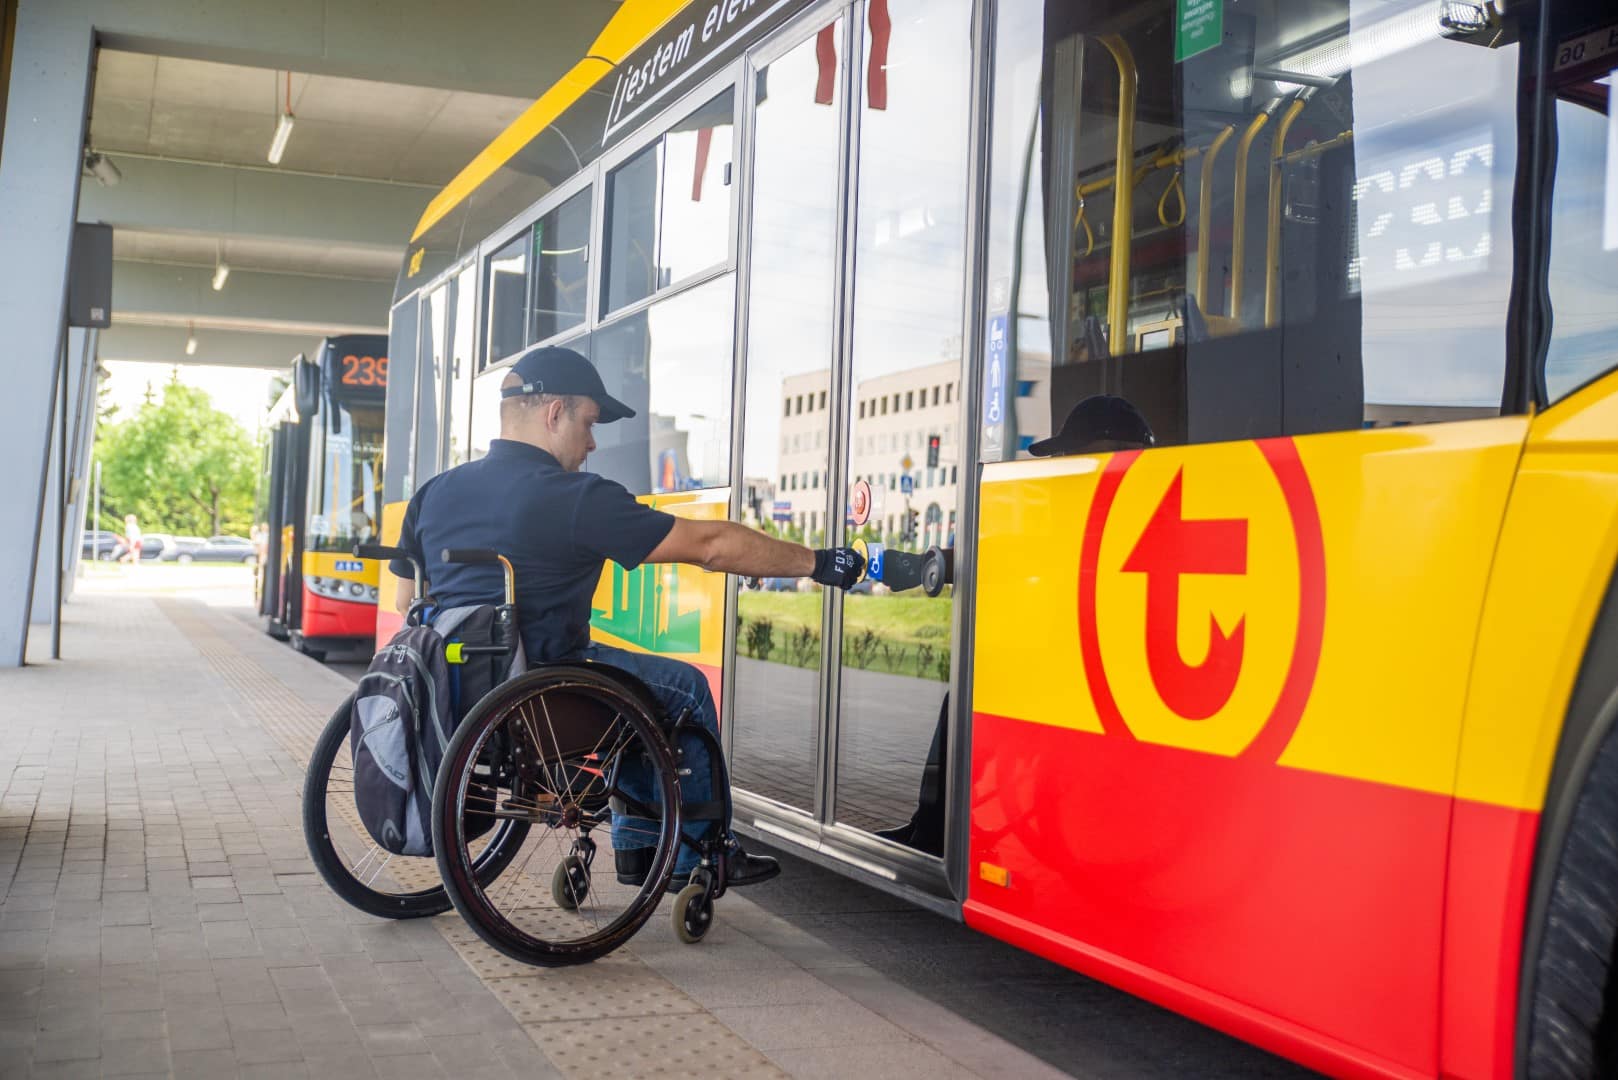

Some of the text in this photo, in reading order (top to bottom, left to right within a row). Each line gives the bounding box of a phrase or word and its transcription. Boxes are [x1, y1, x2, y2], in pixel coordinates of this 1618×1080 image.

[613, 23, 696, 123] jestem
[341, 354, 388, 387] 239
[834, 549, 846, 574] FOX
